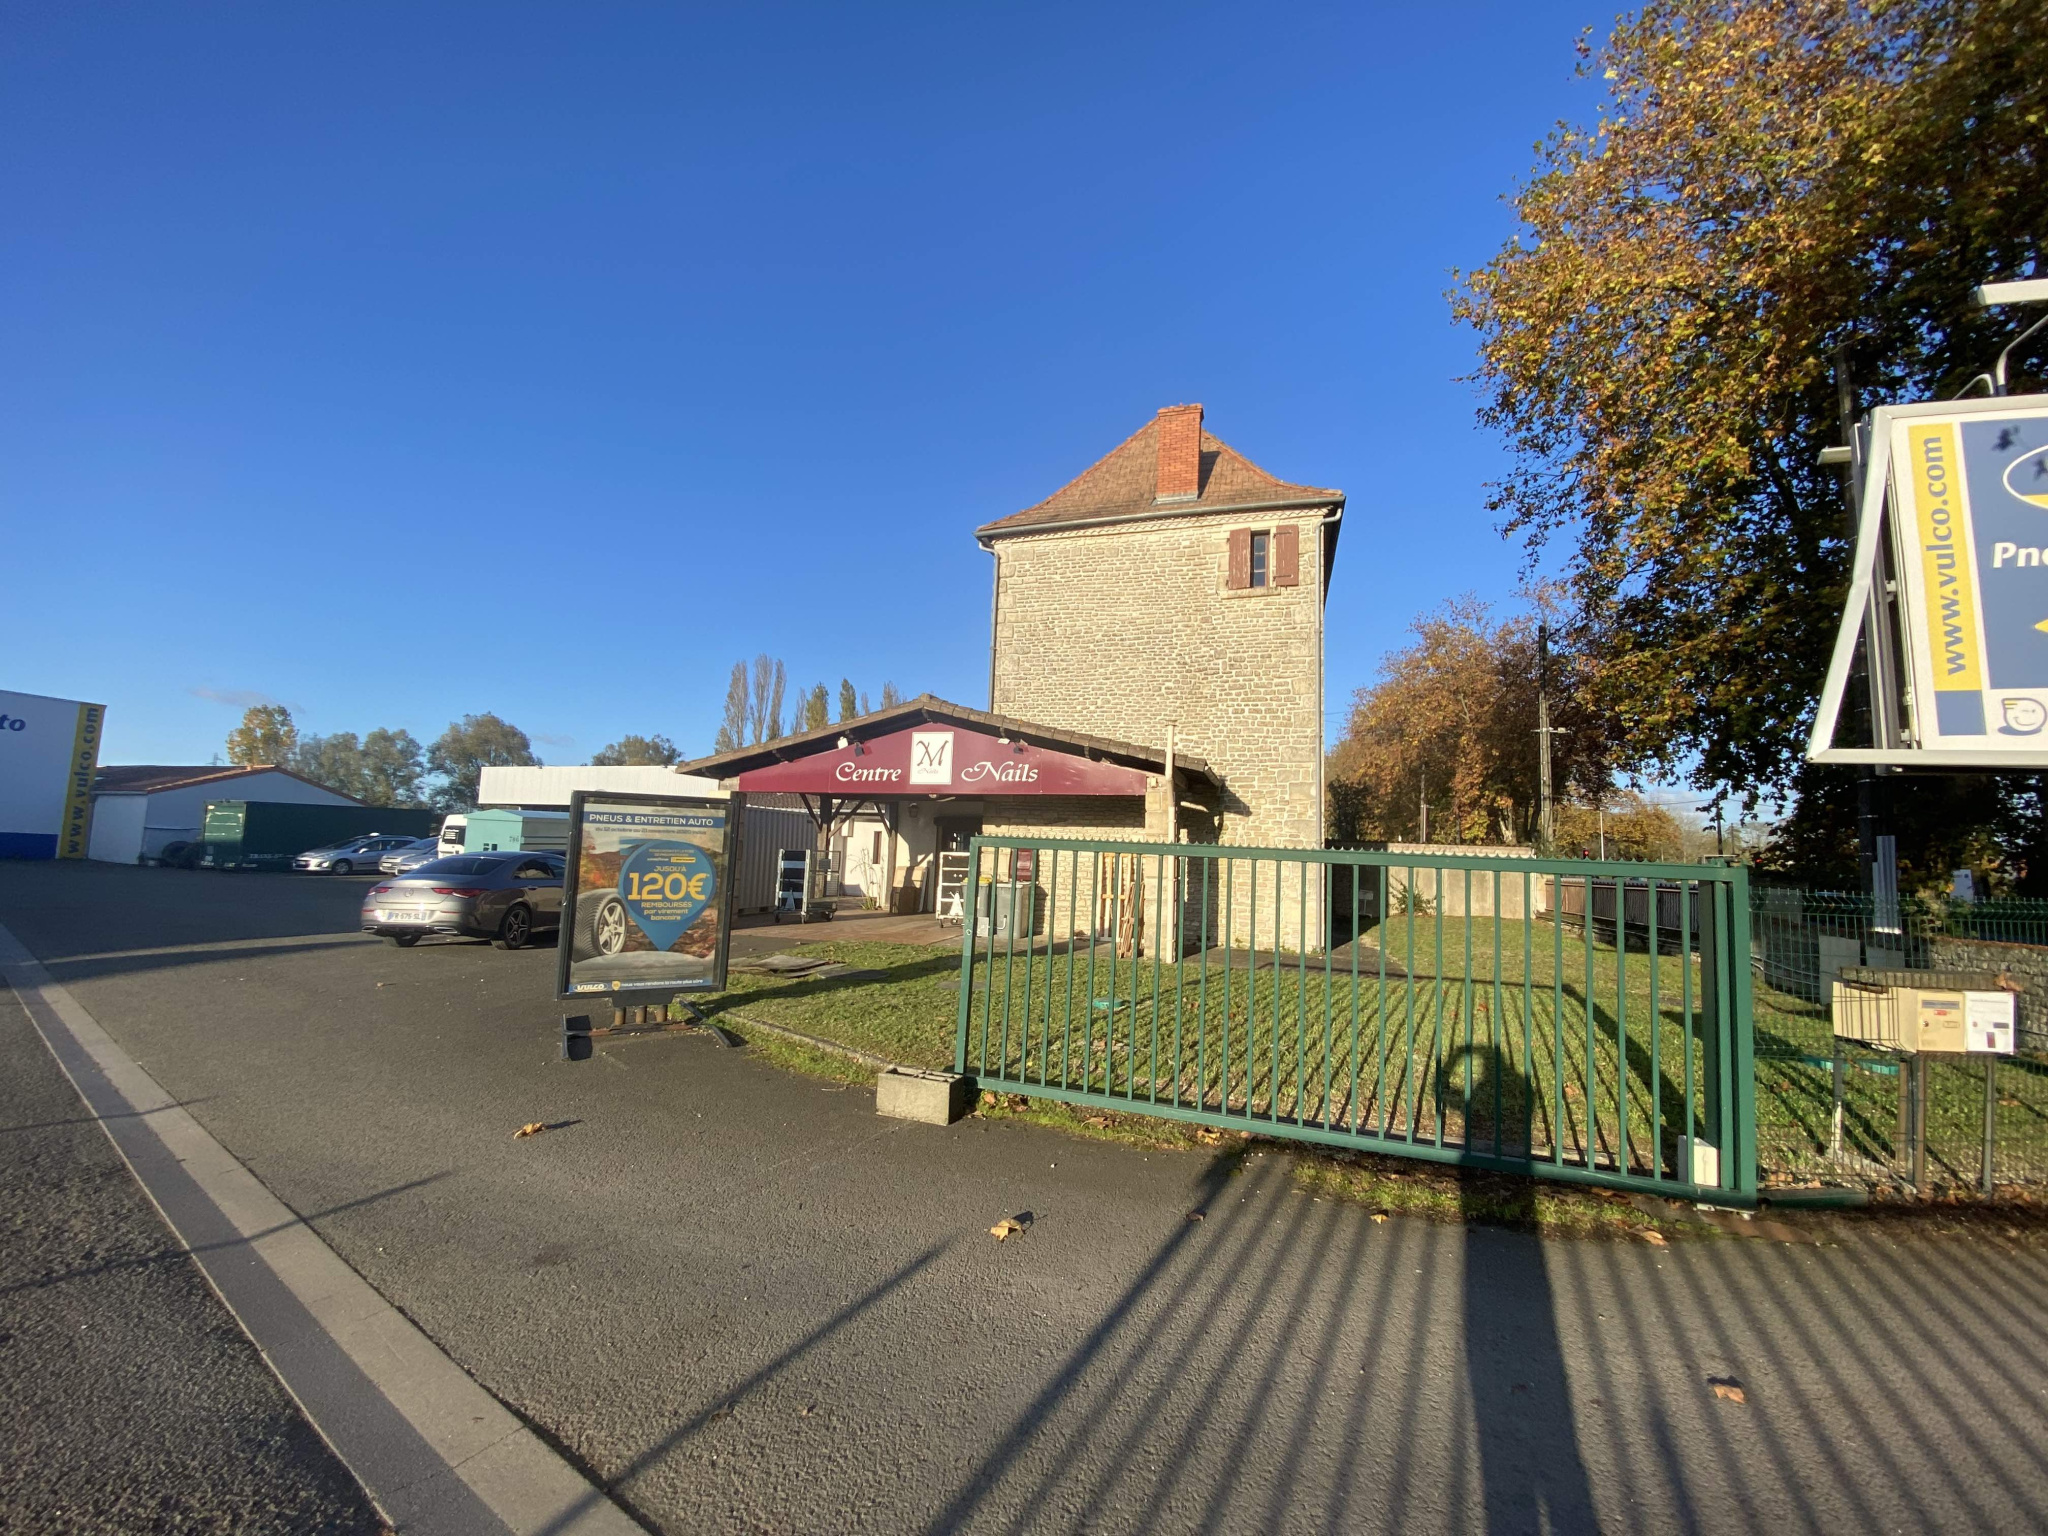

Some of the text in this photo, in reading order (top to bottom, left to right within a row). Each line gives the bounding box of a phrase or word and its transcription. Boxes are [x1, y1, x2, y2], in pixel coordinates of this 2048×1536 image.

[1922, 436, 1966, 676] www.vulco.com
[915, 740, 949, 767] M
[68, 707, 99, 853] www.vulco.com
[836, 761, 1039, 782] Centre Nails
[589, 814, 714, 826] PNEUS & ENTRETIEN AUTO
